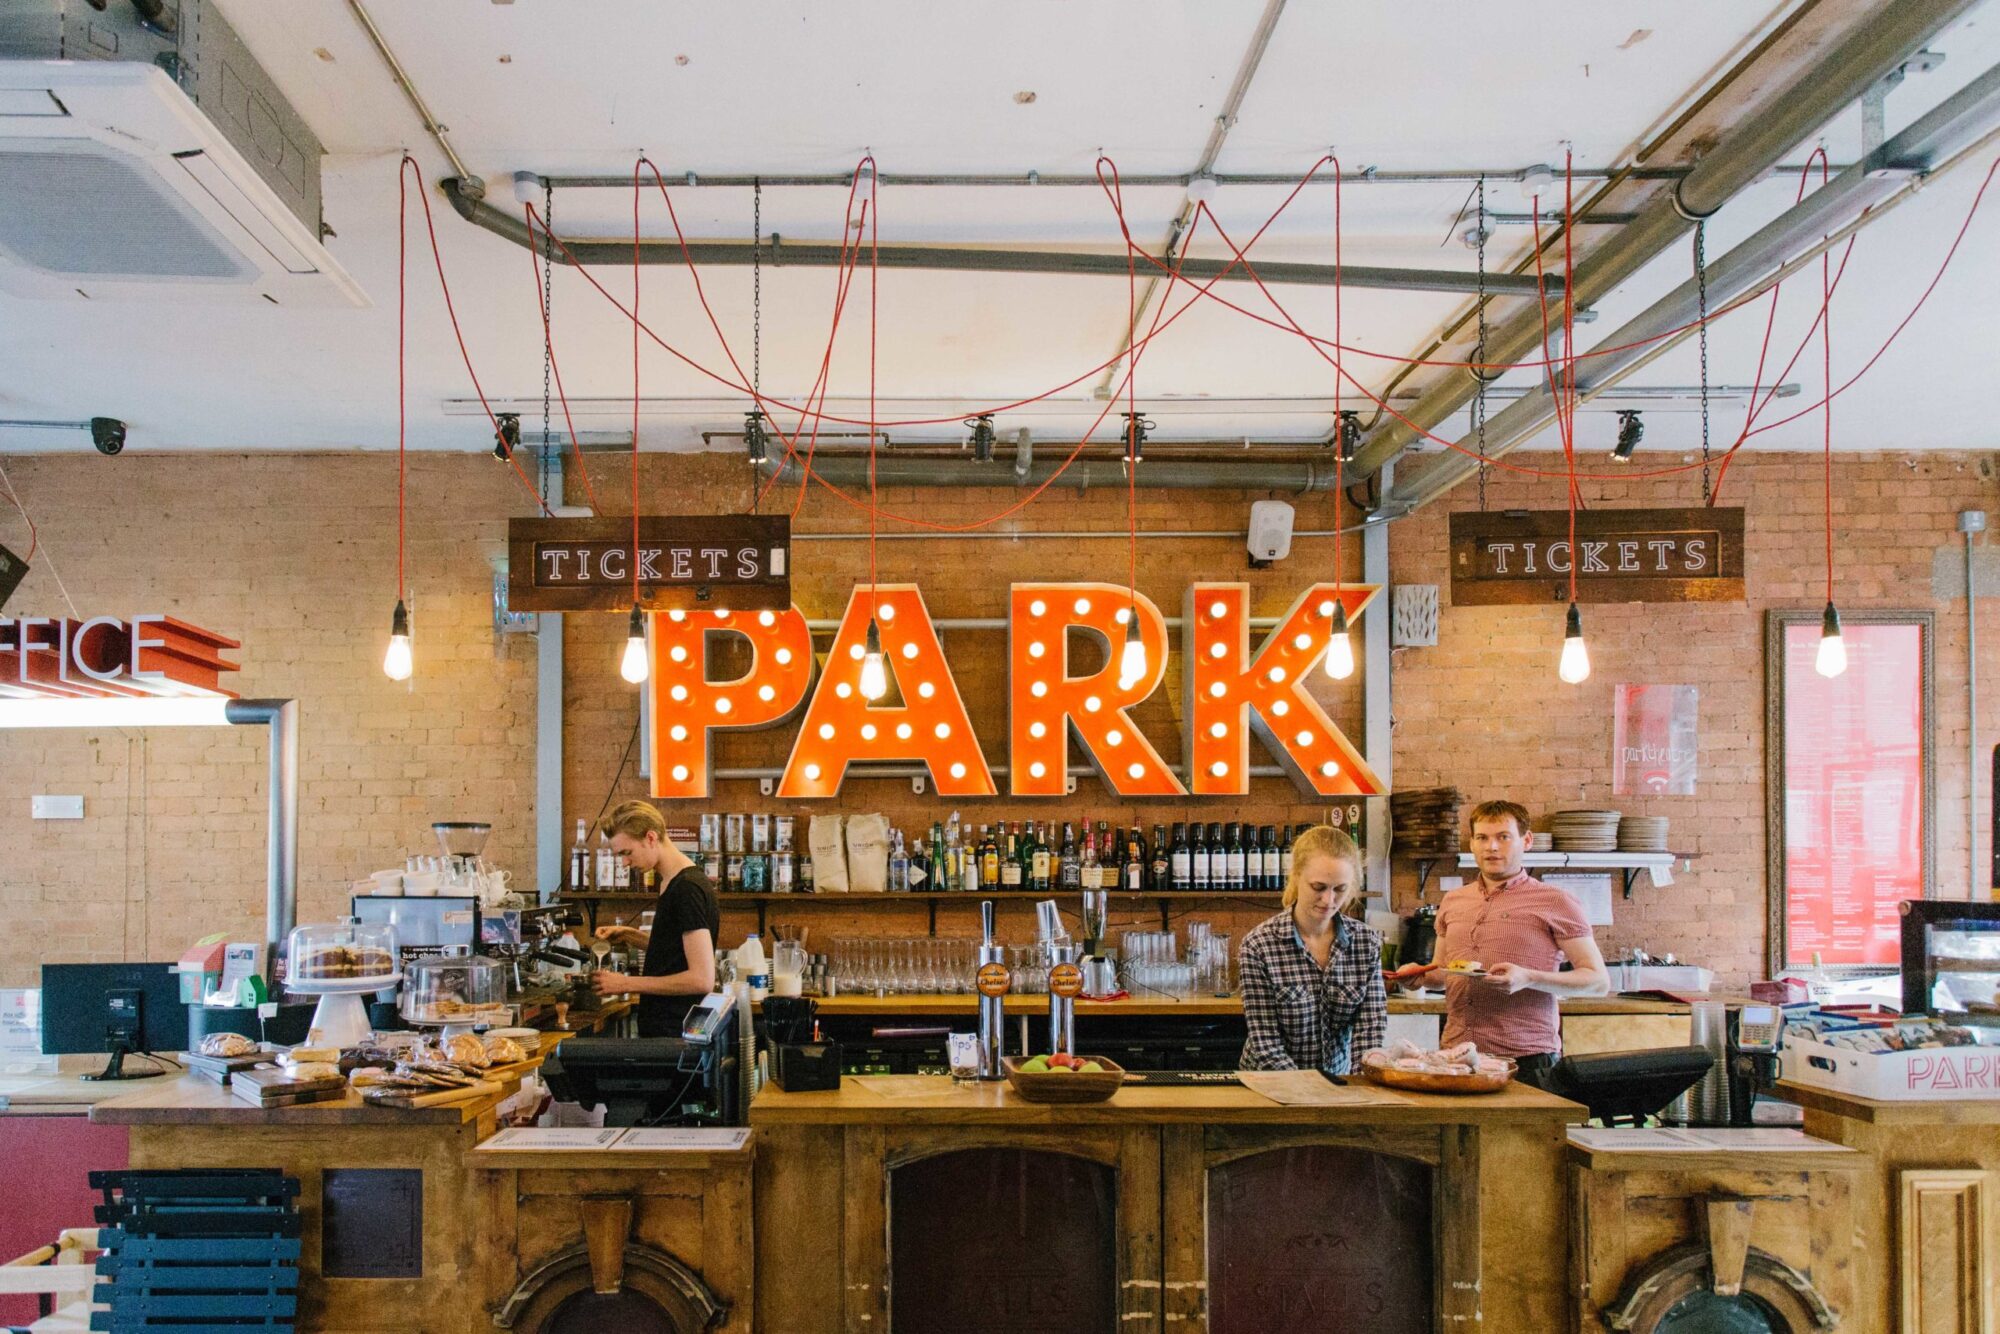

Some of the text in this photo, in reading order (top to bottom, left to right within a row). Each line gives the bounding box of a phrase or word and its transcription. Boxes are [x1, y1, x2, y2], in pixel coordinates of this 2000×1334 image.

[542, 547, 758, 580] TICKETS
[1488, 540, 1706, 573] TICKETS
[649, 581, 1392, 798] PARK
[1907, 1055, 2000, 1090] PAR
